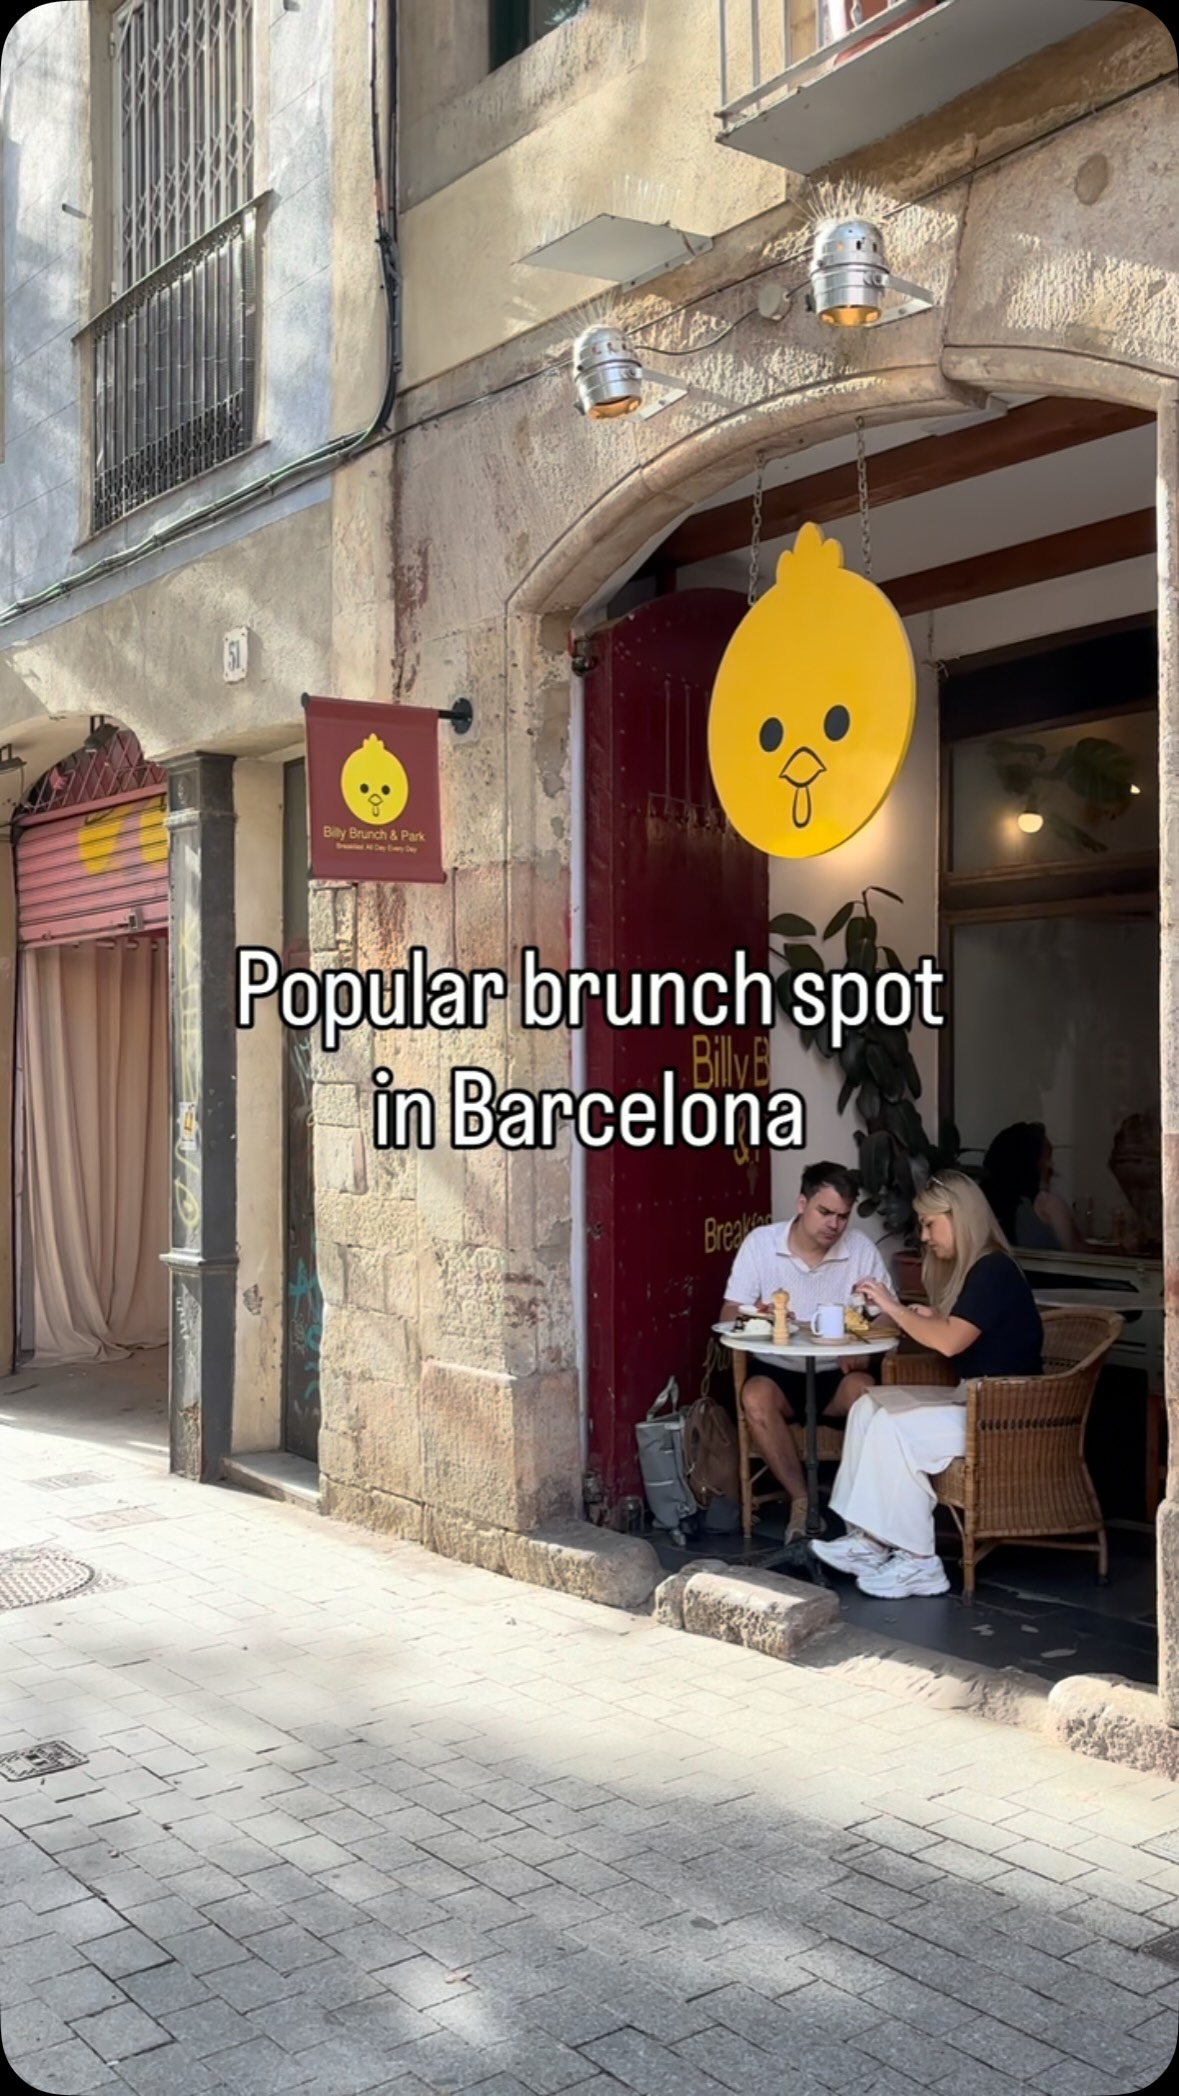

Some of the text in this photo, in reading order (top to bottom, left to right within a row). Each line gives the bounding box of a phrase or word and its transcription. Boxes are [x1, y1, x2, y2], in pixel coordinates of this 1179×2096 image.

[228, 640, 240, 672] 51
[323, 825, 426, 843] Billy Brunch & Park
[374, 844, 386, 853] Day
[405, 845, 418, 854] Day
[692, 1034, 750, 1090] Billy
